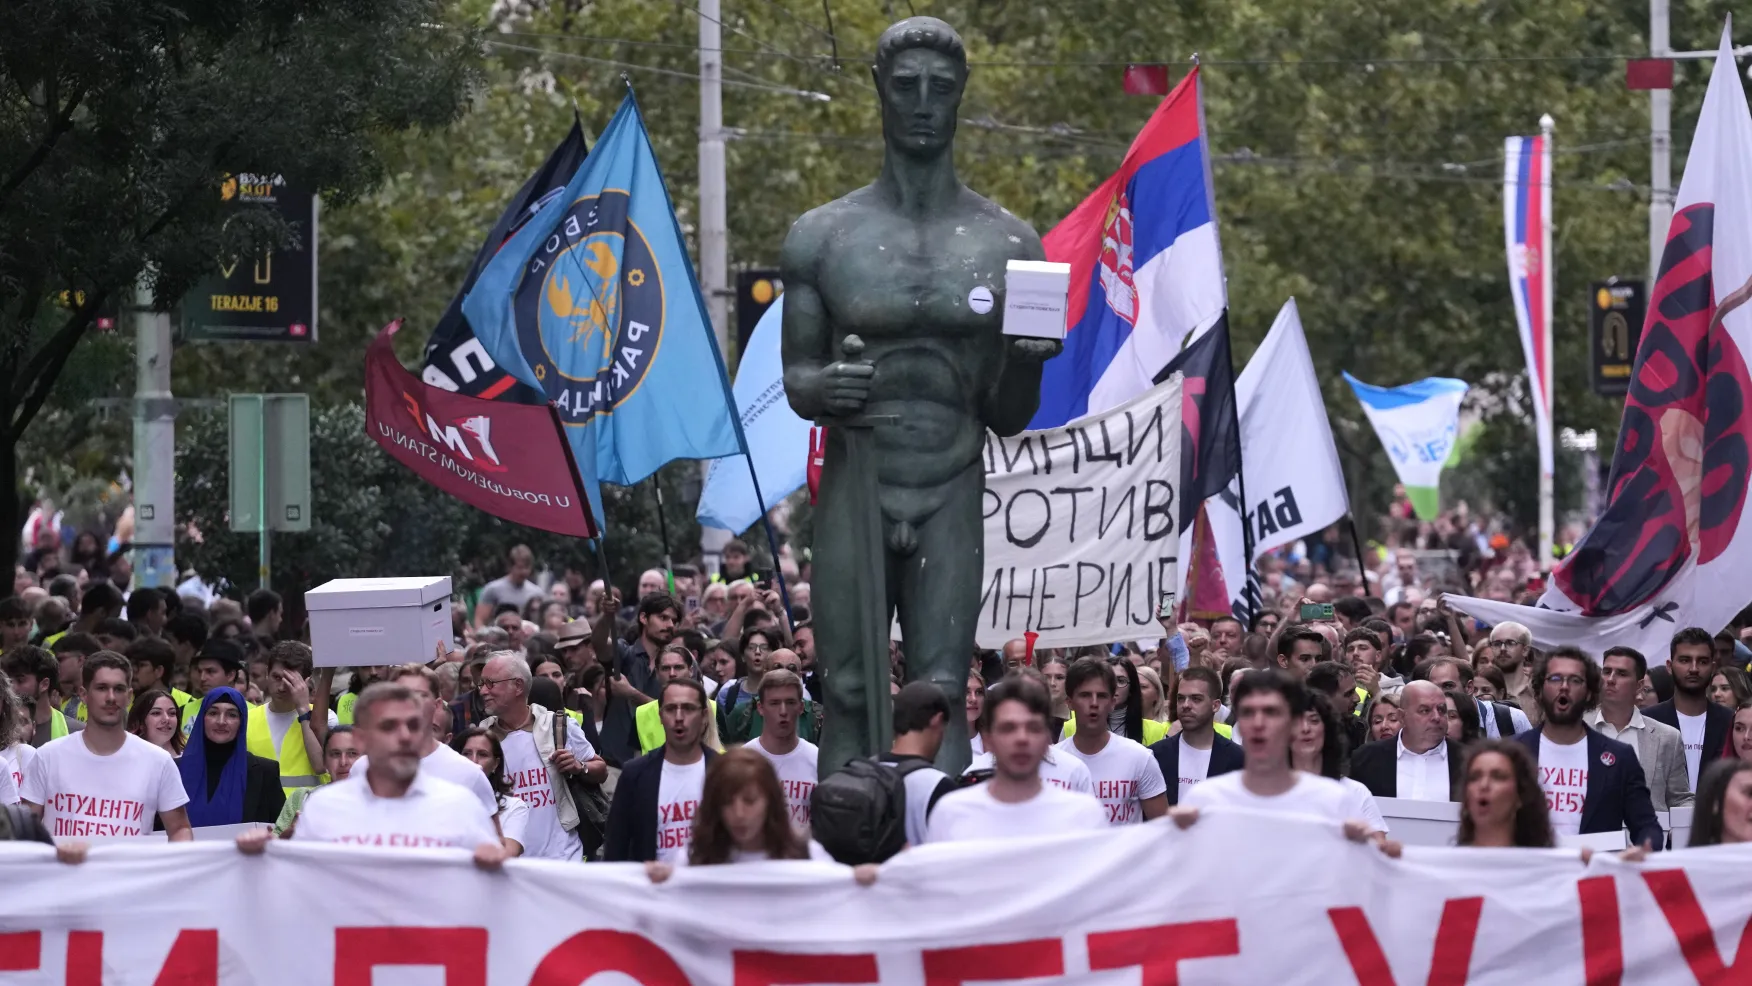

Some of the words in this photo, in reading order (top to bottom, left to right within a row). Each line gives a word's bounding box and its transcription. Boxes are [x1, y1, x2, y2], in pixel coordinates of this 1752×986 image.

[211, 295, 263, 312] TERAZIJE
[265, 296, 279, 313] 16
[983, 479, 1175, 548] РОТИВ
[1541, 767, 1588, 788] УДЕН
[1092, 780, 1138, 799] ЕНТИ
[54, 792, 144, 823] СТУДЕНТИ
